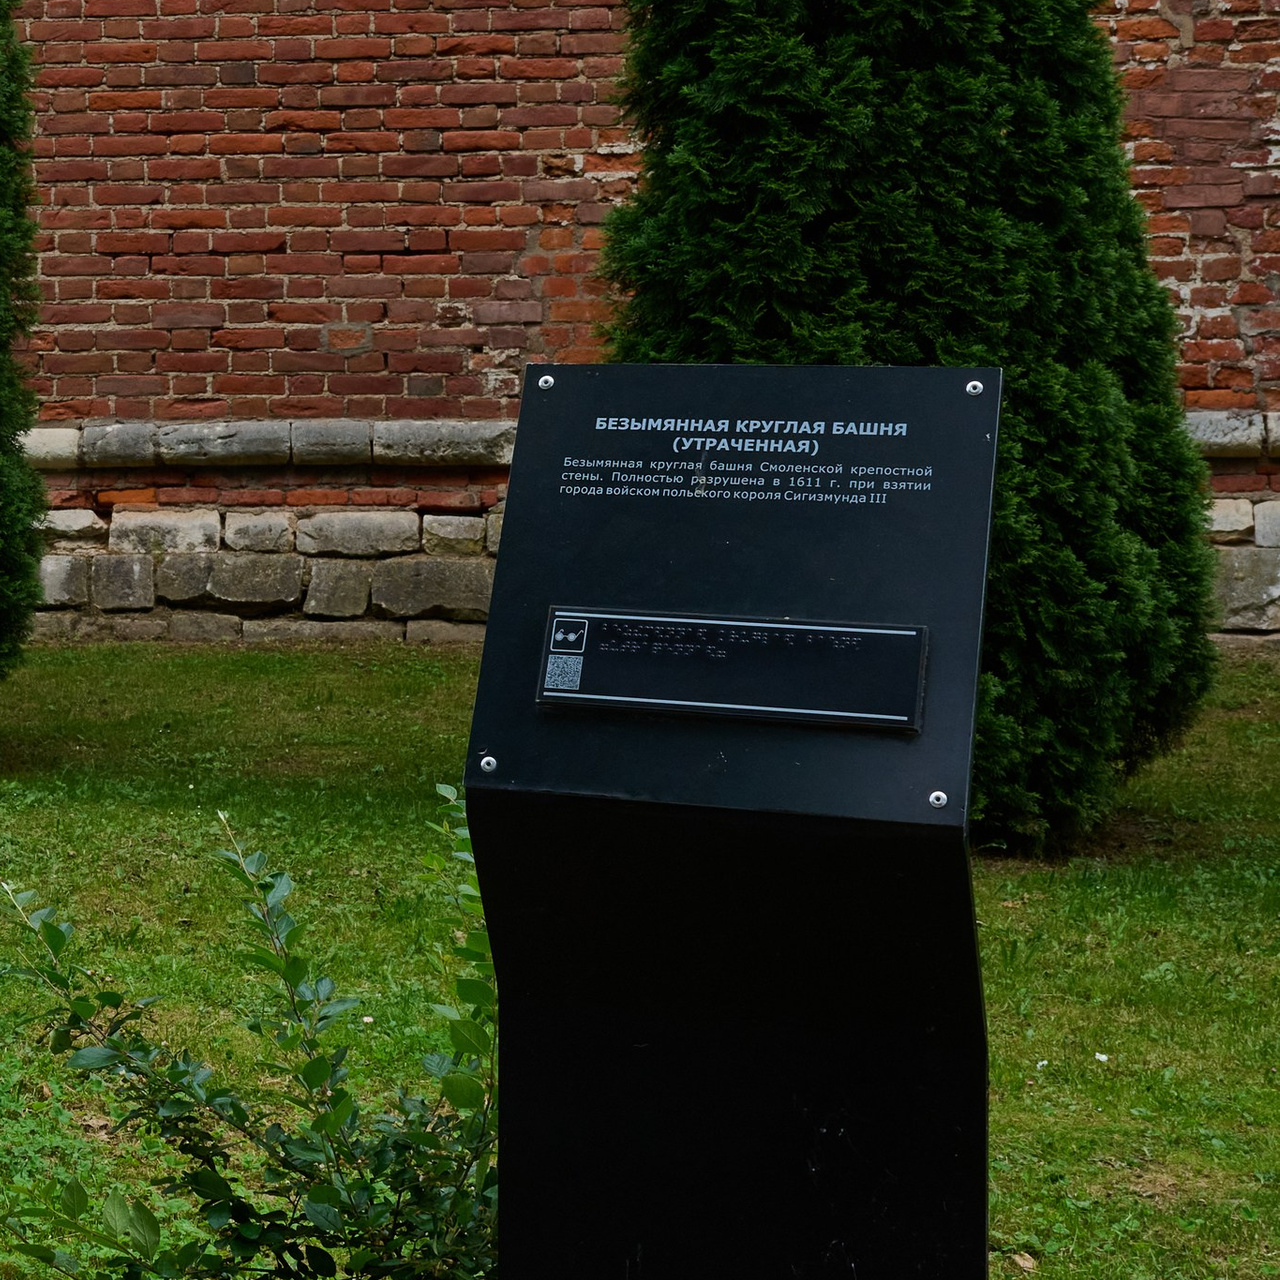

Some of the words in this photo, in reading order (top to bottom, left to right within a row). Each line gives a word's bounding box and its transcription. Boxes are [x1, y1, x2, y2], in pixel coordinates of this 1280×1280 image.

[595, 418, 729, 433] БЕЗЫМЯННАЯ
[736, 420, 825, 434] КРУГЛАЯ
[832, 421, 907, 436] БАШНЯ
[673, 437, 819, 456] (УТРАЧЕННАЯ)
[563, 457, 643, 468] Безымянная
[650, 461, 702, 471] круглая
[709, 460, 752, 471] башня
[760, 461, 843, 474] Смоленской
[850, 465, 933, 477] крепостной
[561, 471, 603, 481] стены.
[611, 472, 684, 483] Полностью
[691, 476, 765, 487] разрушена
[773, 478, 780, 486] в
[789, 477, 822, 487] 1611
[830, 480, 841, 488] г.
[849, 480, 876, 491] при
[883, 480, 932, 491] взятии
[560, 486, 604, 498] города
[606, 487, 660, 497] войском
[662, 488, 732, 499] польского
[734, 490, 781, 501] короля
[784, 491, 867, 504] Сигизмунда
[869, 493, 887, 503] III
